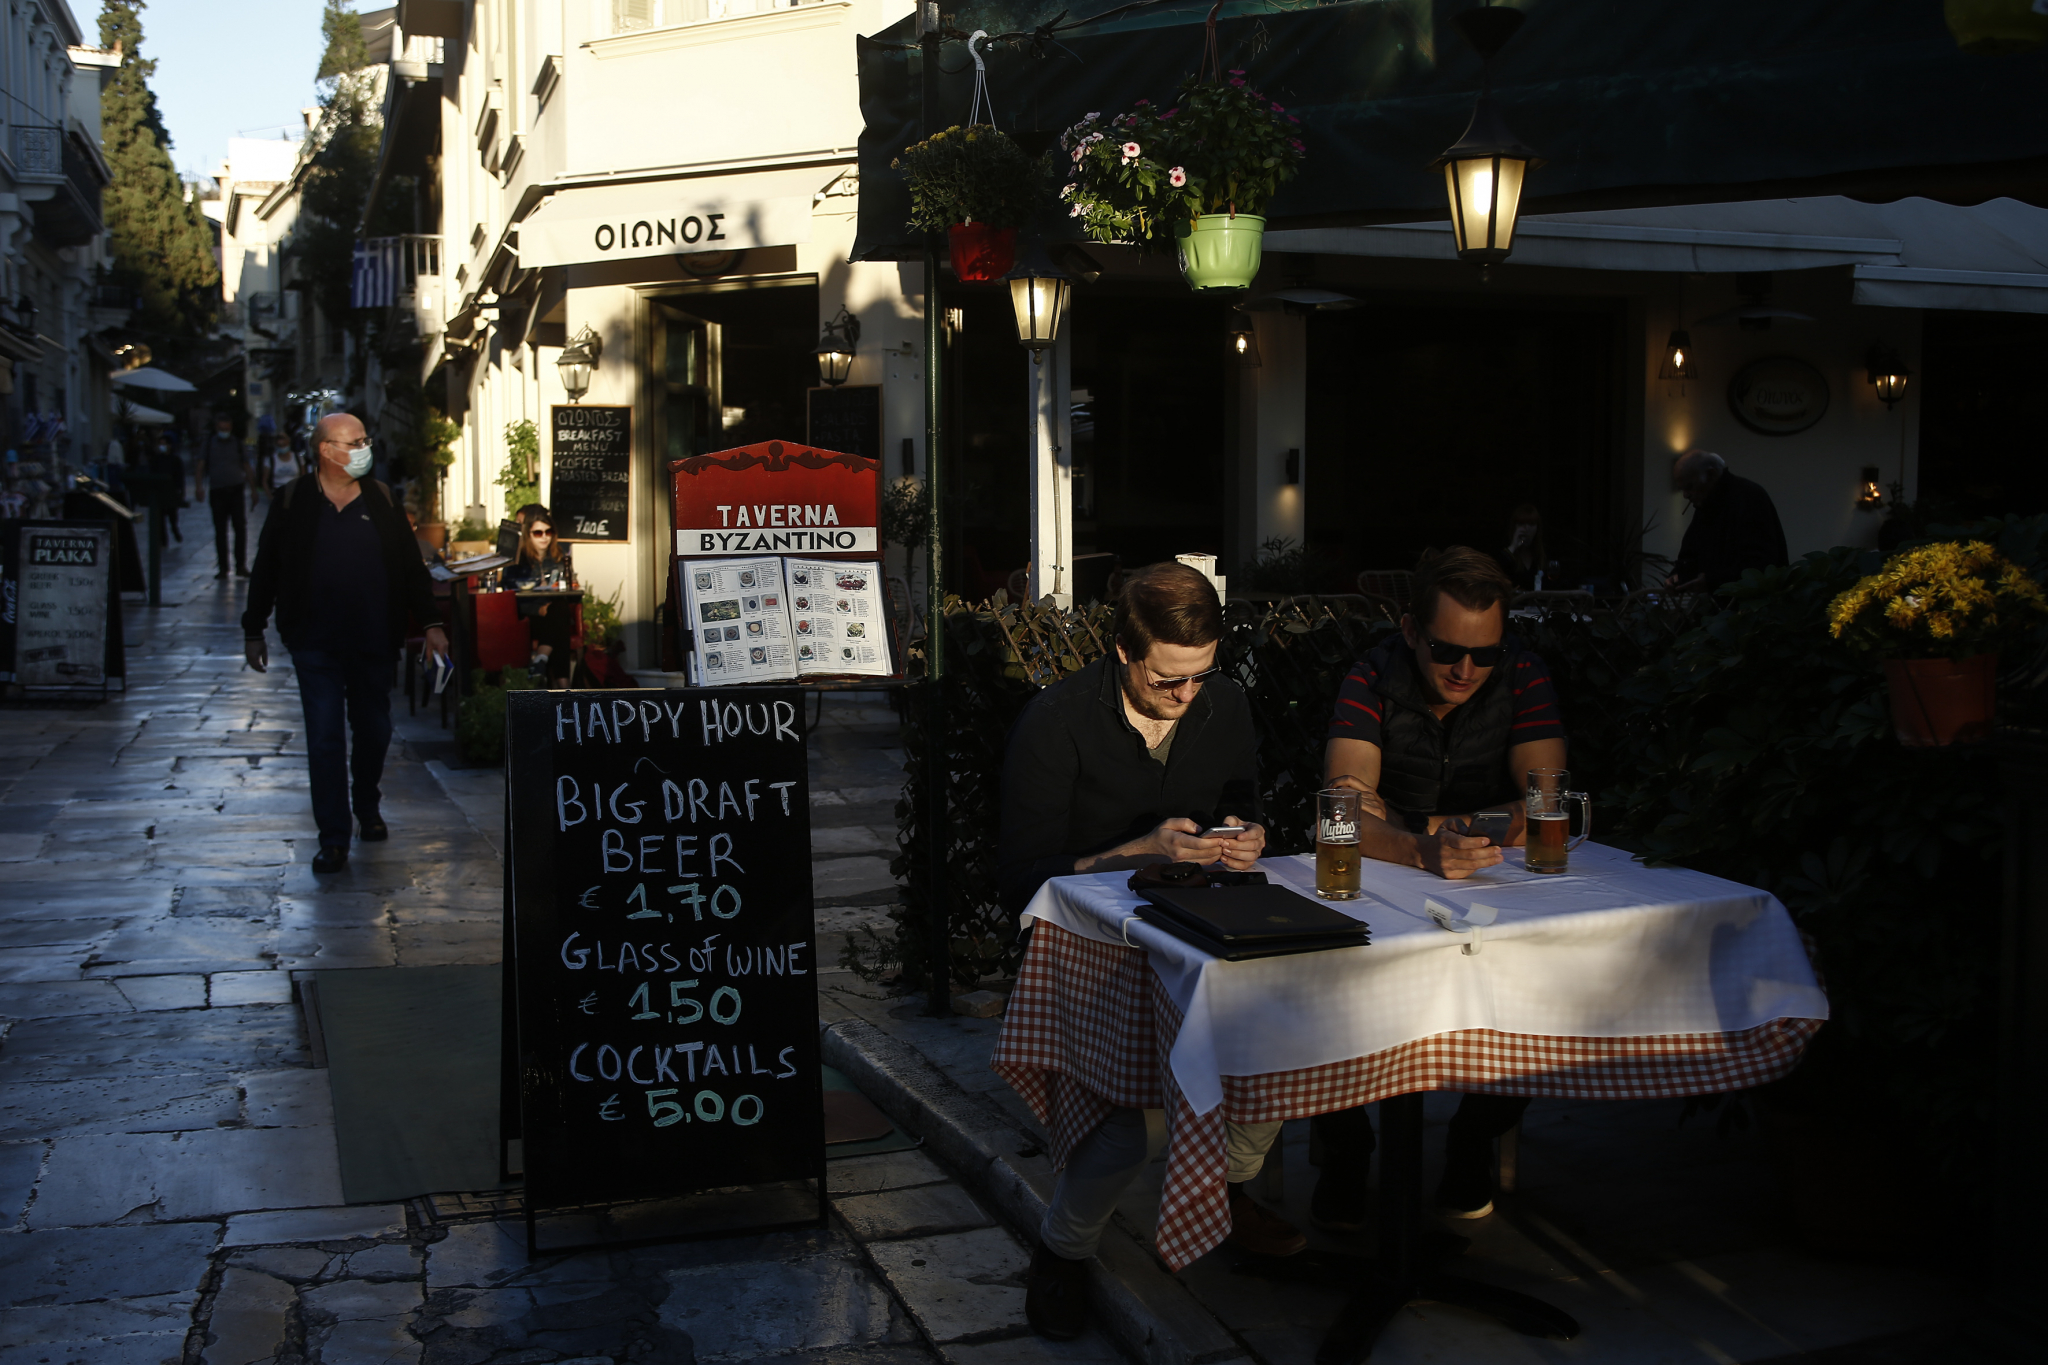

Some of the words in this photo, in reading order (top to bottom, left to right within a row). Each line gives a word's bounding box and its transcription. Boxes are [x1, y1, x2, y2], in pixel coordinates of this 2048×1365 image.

[595, 213, 725, 251] ΟΙΩΝΟΣ
[557, 429, 623, 442] BREAKFAST
[572, 441, 609, 451] MENU
[559, 457, 604, 470] COFFEE
[560, 471, 598, 482] TOASTED
[601, 472, 629, 483] BREAD
[716, 504, 840, 527] TAVERNA
[36, 538, 95, 549] TAVERNA
[700, 531, 856, 552] BYZANTINO
[35, 549, 94, 563] PLAKA
[556, 699, 685, 745] HAPPY
[699, 698, 800, 746] HOUR
[556, 774, 647, 832] BIG
[662, 778, 797, 823] DRAFT
[1320, 819, 1355, 841] Mythos
[602, 828, 746, 877] BEER
[577, 885, 602, 911] €
[560, 931, 682, 974] GLASS
[726, 941, 808, 976] WINE
[577, 990, 600, 1015] €
[568, 1041, 798, 1086] COCKTAILS
[598, 1092, 626, 1121] €
